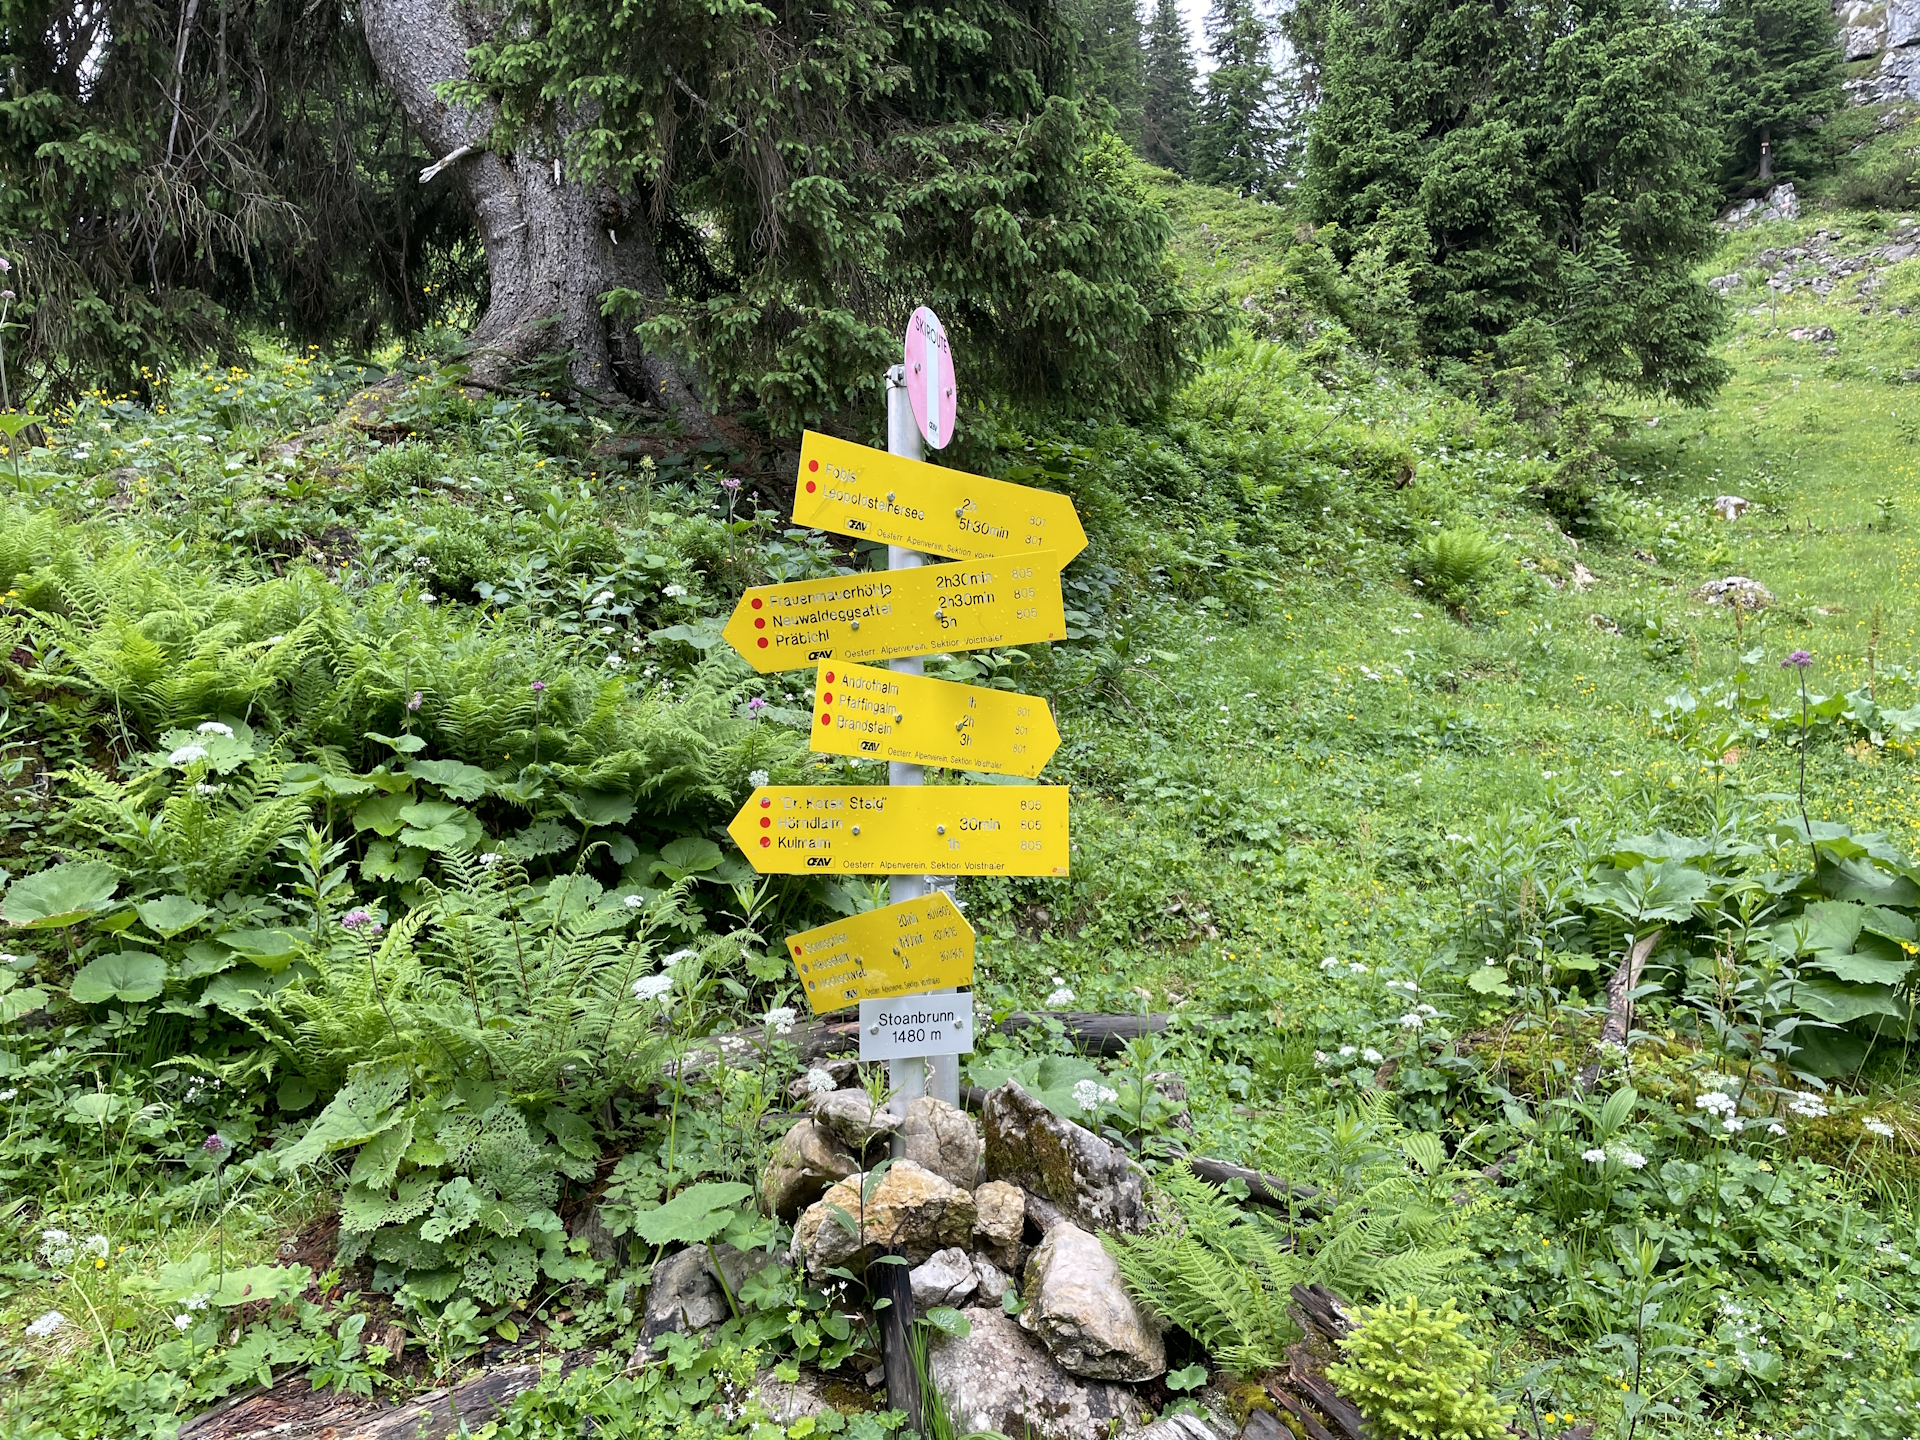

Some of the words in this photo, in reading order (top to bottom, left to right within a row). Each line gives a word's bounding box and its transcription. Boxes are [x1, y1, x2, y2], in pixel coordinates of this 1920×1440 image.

[915, 315, 947, 353] SKIROUTE
[825, 463, 856, 484] Fobis
[962, 498, 977, 513] 2h
[1029, 516, 1046, 528] 801
[823, 484, 925, 520] Leopoldsteinersee
[959, 518, 1009, 540] 5h30min
[1025, 534, 1042, 546] 801
[947, 544, 972, 556] Sektion
[770, 582, 892, 608] Frauenmauerhöhle
[936, 571, 992, 589] 2h30min
[1011, 568, 1034, 580] 805
[772, 602, 892, 628] Neuwaldeggsattel
[938, 591, 995, 609] 2h30min
[1014, 588, 1036, 600] 805
[776, 630, 830, 647] Präbichl
[940, 615, 958, 629] 5h
[1016, 608, 1038, 620] 805
[930, 638, 960, 649] Sektion
[840, 674, 900, 696] Androthalm
[968, 696, 976, 708] 1h
[1016, 706, 1030, 717] 801
[838, 694, 896, 715] Pfaffingalm
[962, 714, 974, 728] 2h
[1014, 726, 1028, 736] 801
[836, 714, 892, 736] Brandstein
[960, 733, 972, 746] 3h
[1012, 744, 1026, 754] 801
[950, 756, 972, 766] Sektion
[806, 797, 844, 810] Kotek
[850, 796, 887, 812] Steig"
[1020, 800, 1042, 810] 805
[778, 816, 843, 830] Hörndlalm
[960, 818, 1000, 831] 30min
[1020, 820, 1042, 830] 805
[778, 836, 831, 849] Kulmalm
[947, 838, 960, 850] 1h
[1020, 840, 1042, 850] 805
[930, 862, 960, 870] Sektion
[896, 912, 919, 928] 20min
[878, 1011, 954, 1026] Stoanbrunn
[892, 1028, 926, 1044] 1480
[930, 1030, 942, 1041] m
